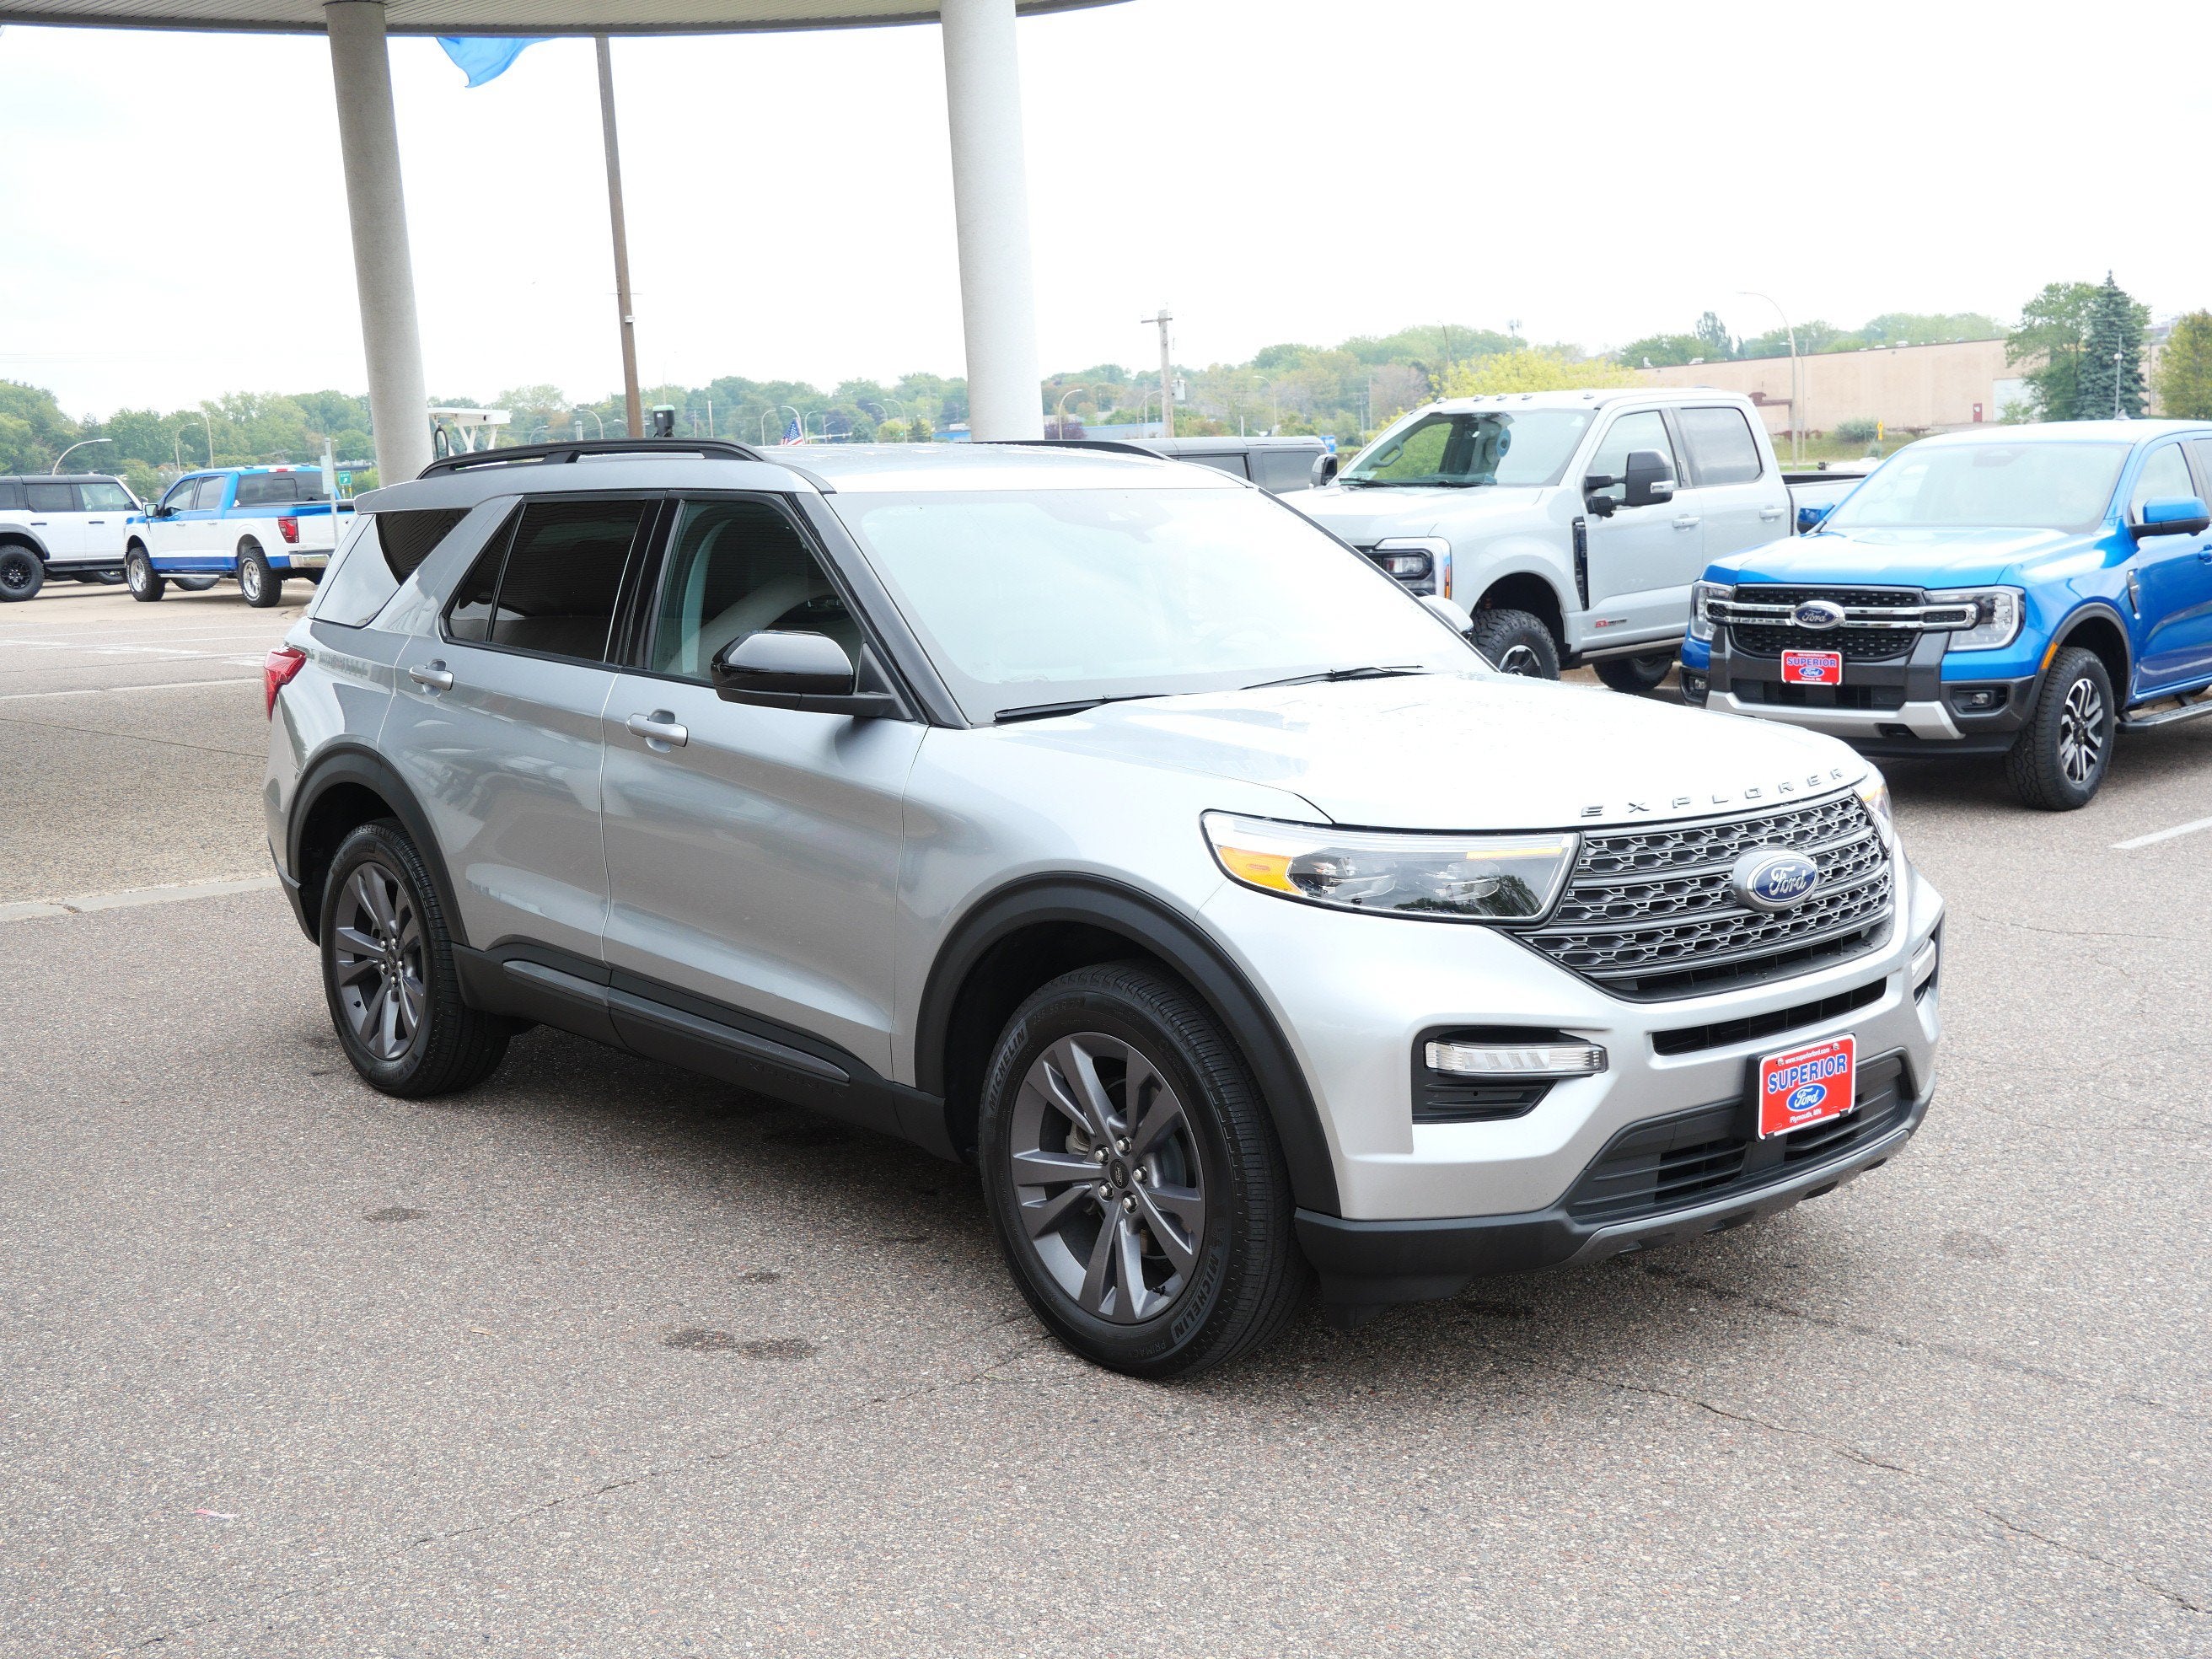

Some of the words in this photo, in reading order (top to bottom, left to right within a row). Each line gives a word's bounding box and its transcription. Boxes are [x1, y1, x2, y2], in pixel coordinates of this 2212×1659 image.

[1801, 609, 1828, 622] Ford
[1786, 657, 1837, 668] SUPERIOR
[1581, 768, 1844, 817] EXPLORER
[1769, 866, 1807, 895] Ford
[989, 1026, 1027, 1112] MICHELIN
[1768, 1054, 1847, 1094] SUPERIOR
[1794, 1087, 1819, 1108] Ford
[1173, 1254, 1221, 1339] MICHELIN
